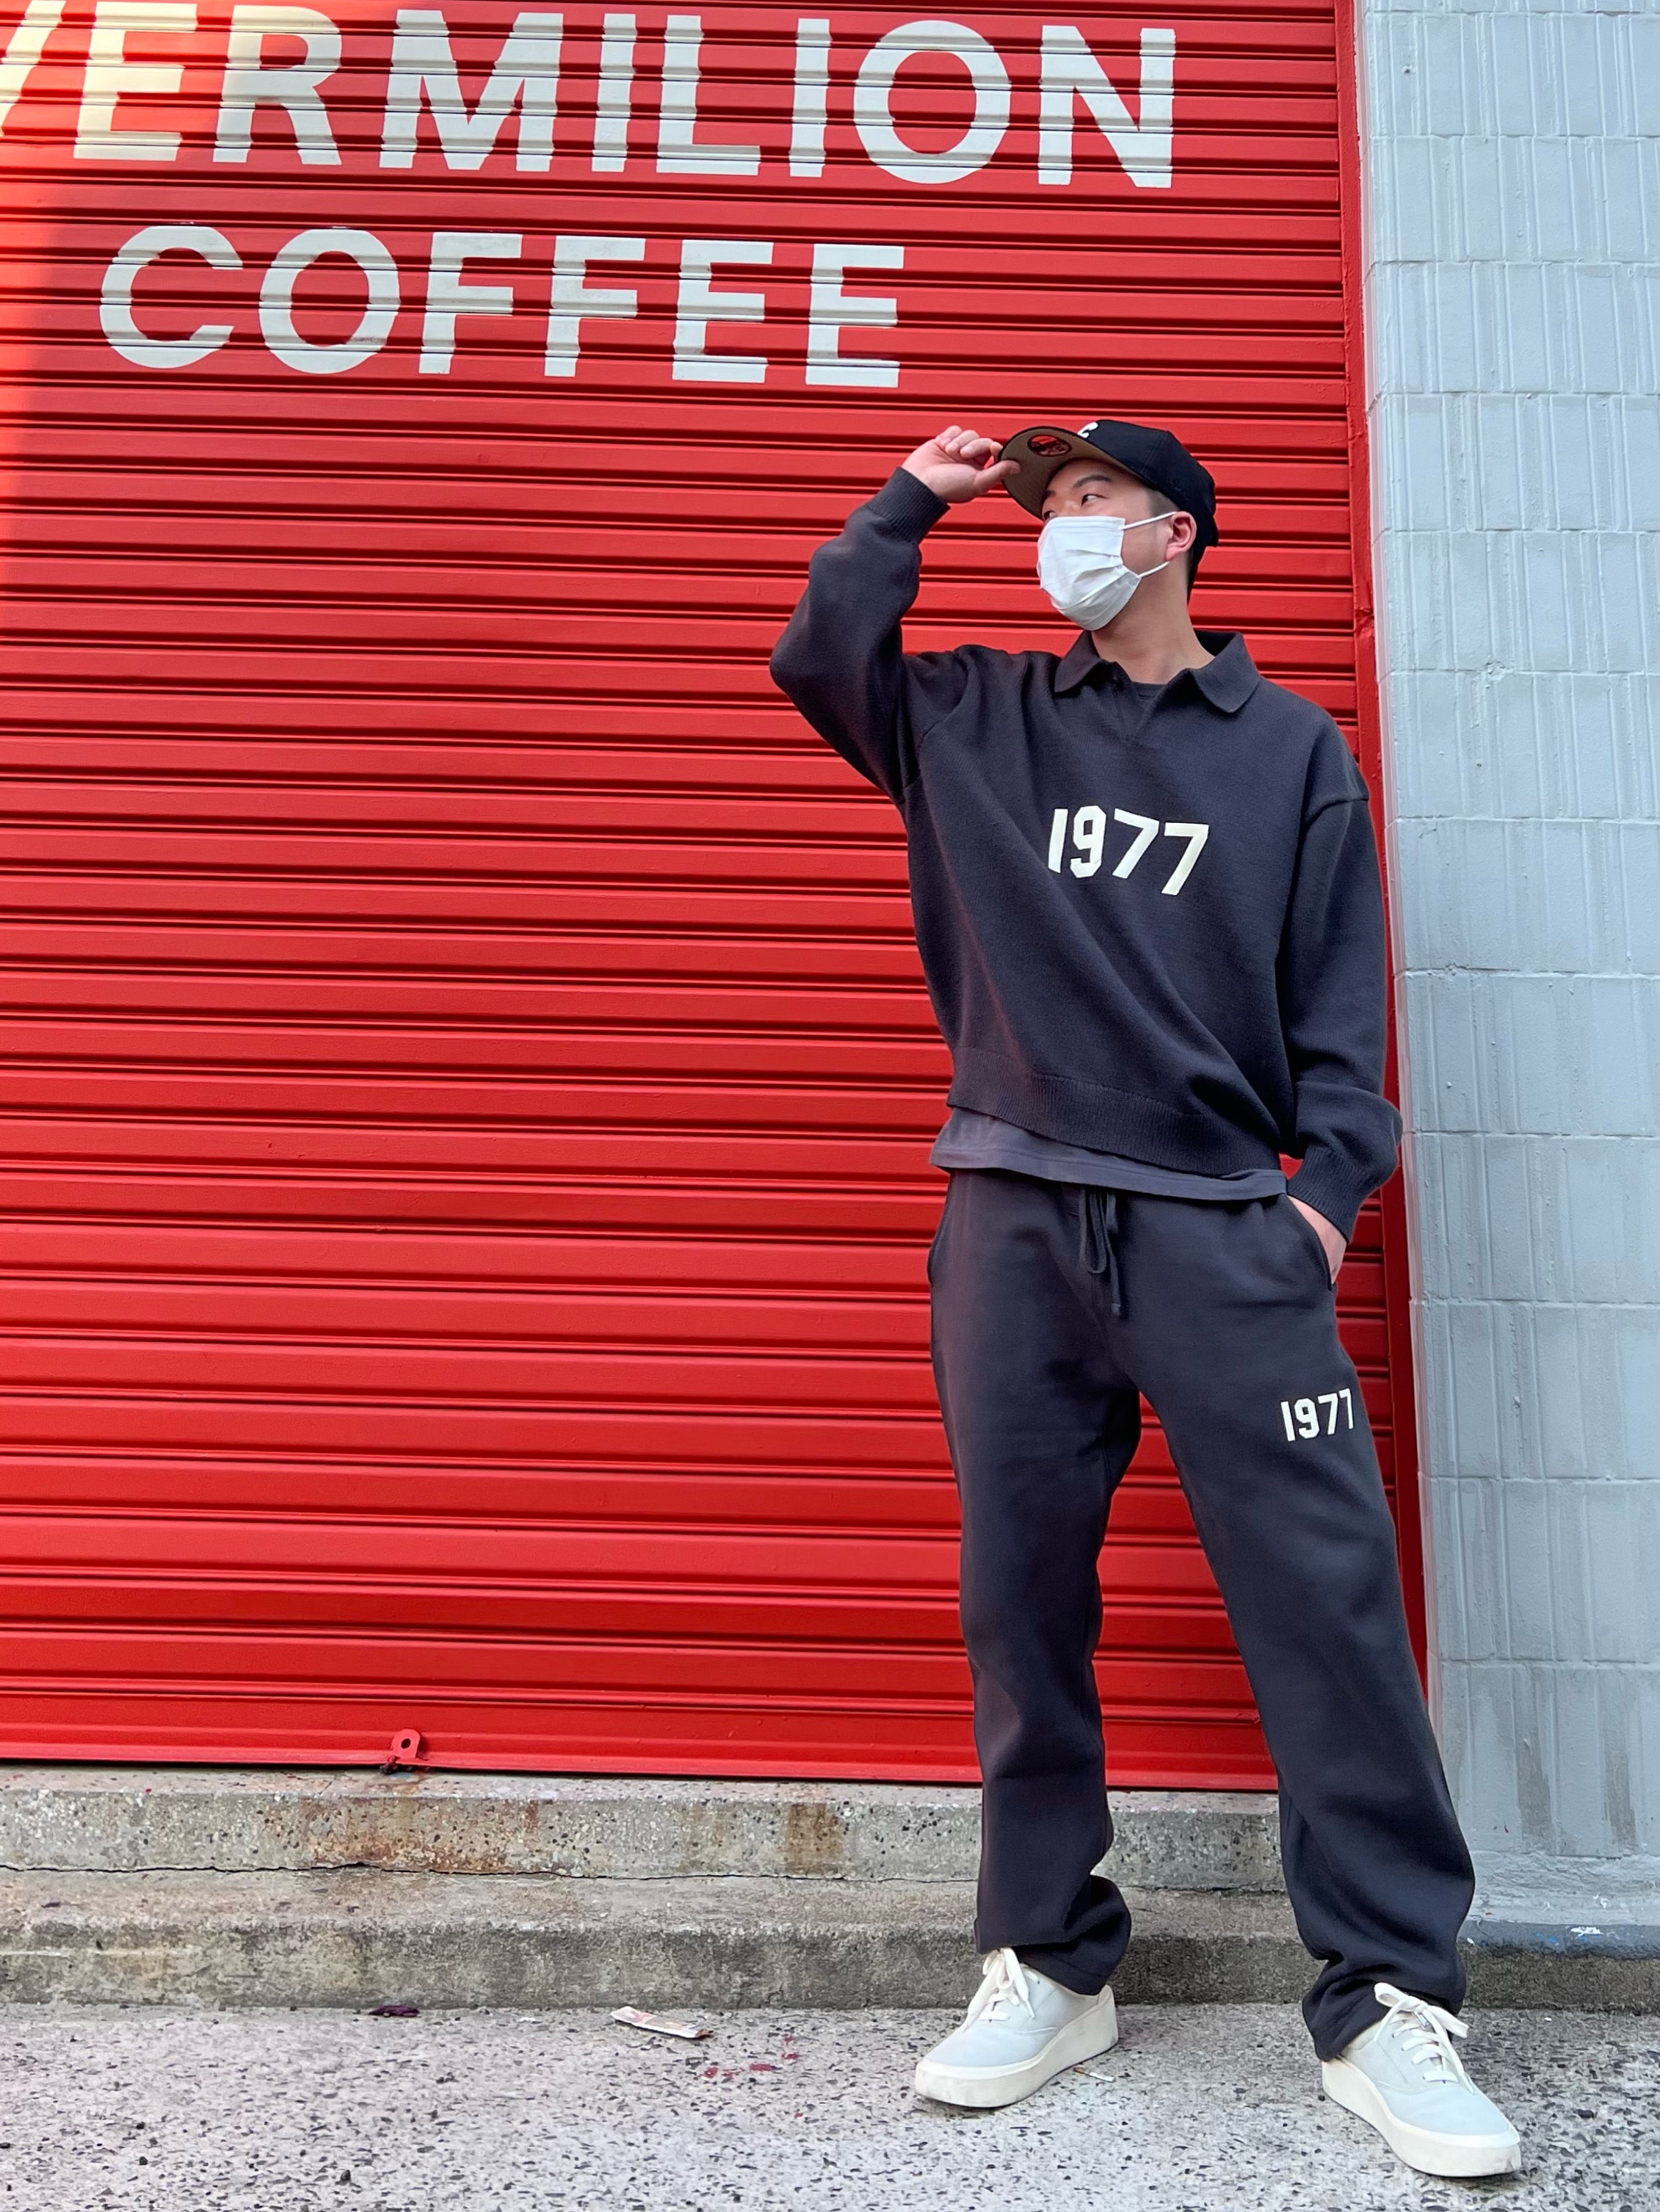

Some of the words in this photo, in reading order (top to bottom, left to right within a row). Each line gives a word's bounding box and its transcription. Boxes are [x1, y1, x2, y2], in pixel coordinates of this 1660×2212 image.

[98, 225, 905, 388] COFFEE
[1048, 805, 1209, 896] 1977
[1280, 1388, 1354, 1442] 1977
